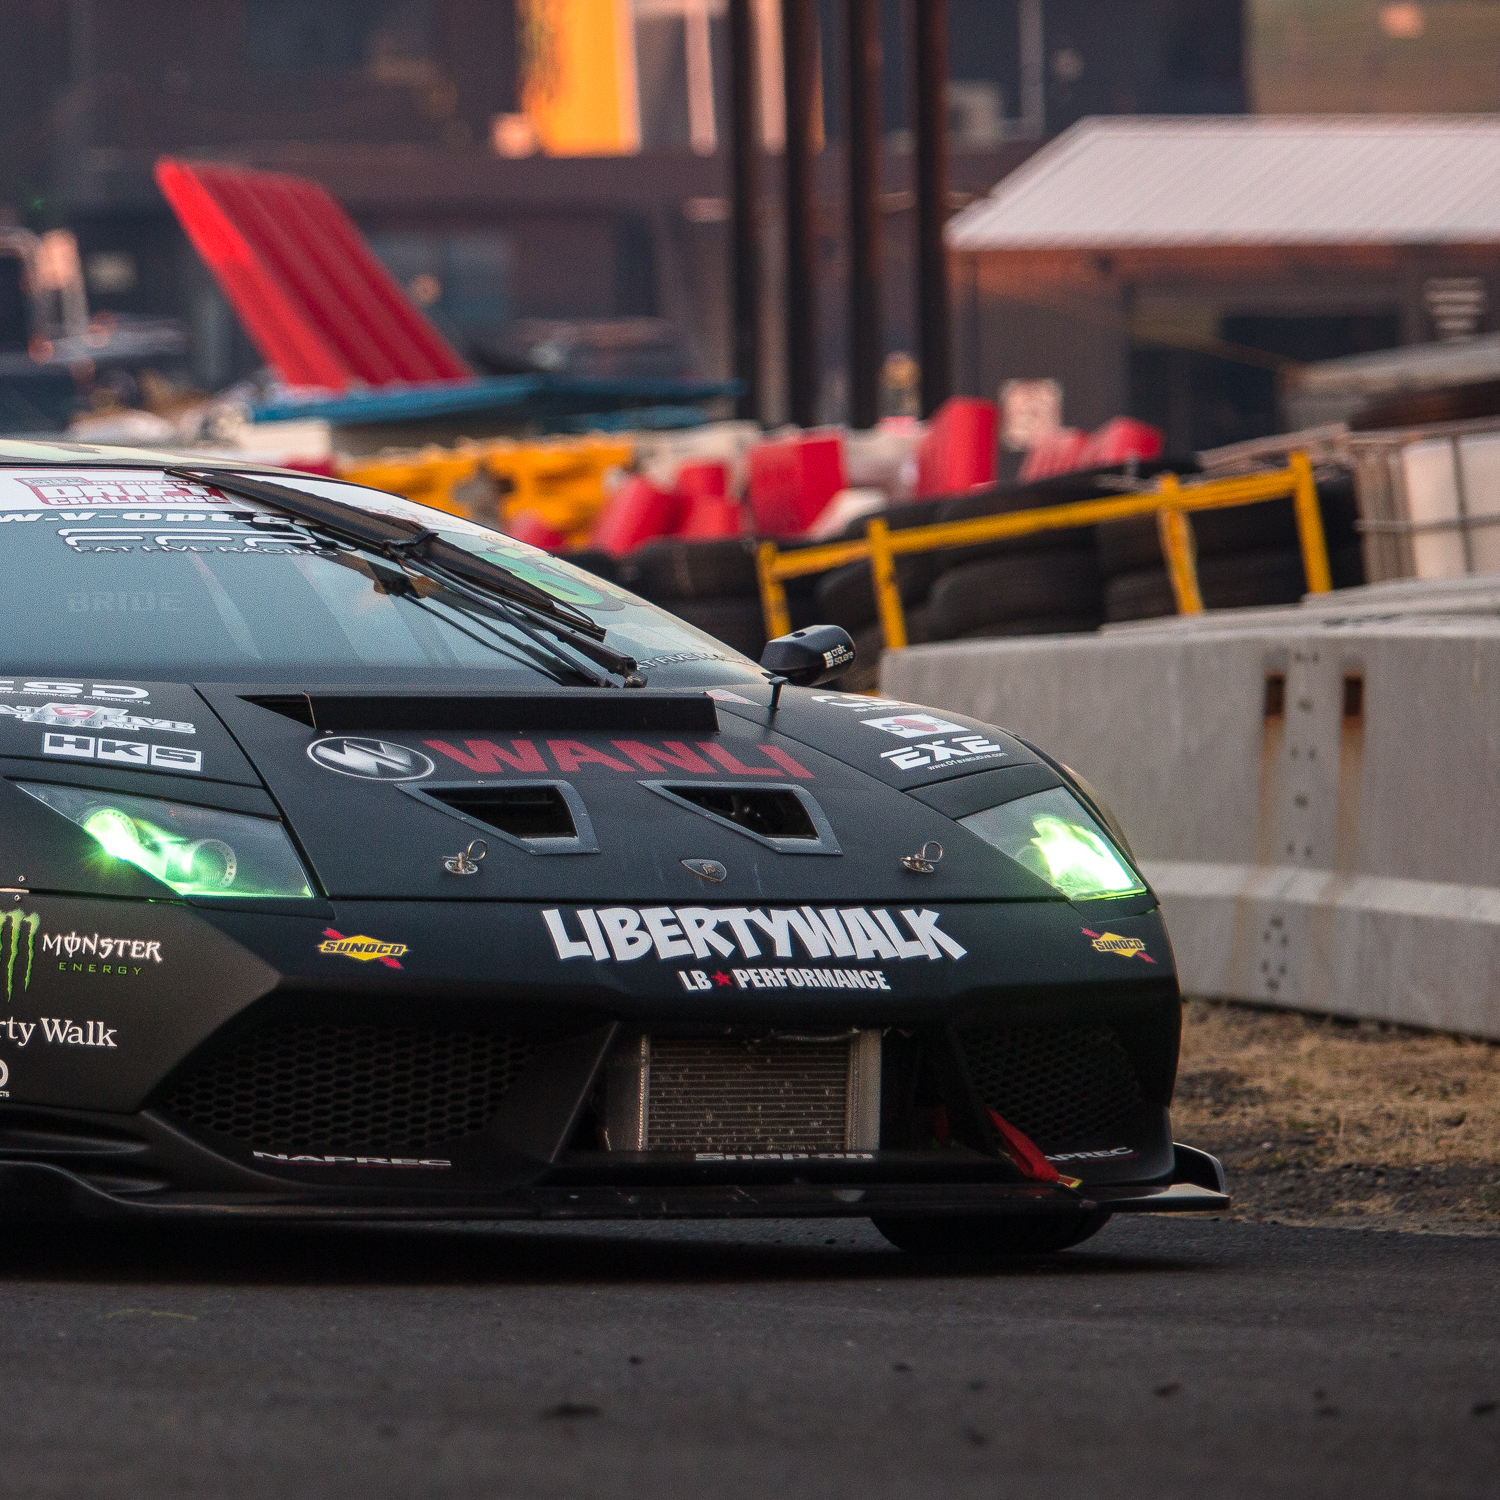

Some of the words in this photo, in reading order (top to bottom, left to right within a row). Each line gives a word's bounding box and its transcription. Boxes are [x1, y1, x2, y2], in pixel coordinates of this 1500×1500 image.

[37, 484, 211, 498] DRIFT
[49, 495, 230, 505] CHALLENGE
[44, 733, 201, 771] HKS
[421, 739, 815, 779] WANLI
[880, 735, 1001, 770] EXE
[541, 905, 967, 962] LIBERTYWALK
[42, 931, 163, 964] MONSTER
[322, 939, 405, 957] SUNOCO
[1094, 938, 1144, 951] SUNOCO
[58, 961, 143, 976] ENERGY
[677, 969, 713, 991] LB
[731, 968, 892, 992] PERFORMANCE
[40, 1017, 118, 1047] Walk
[253, 1150, 452, 1167] NAPREC
[1044, 1146, 1135, 1161] APREC
